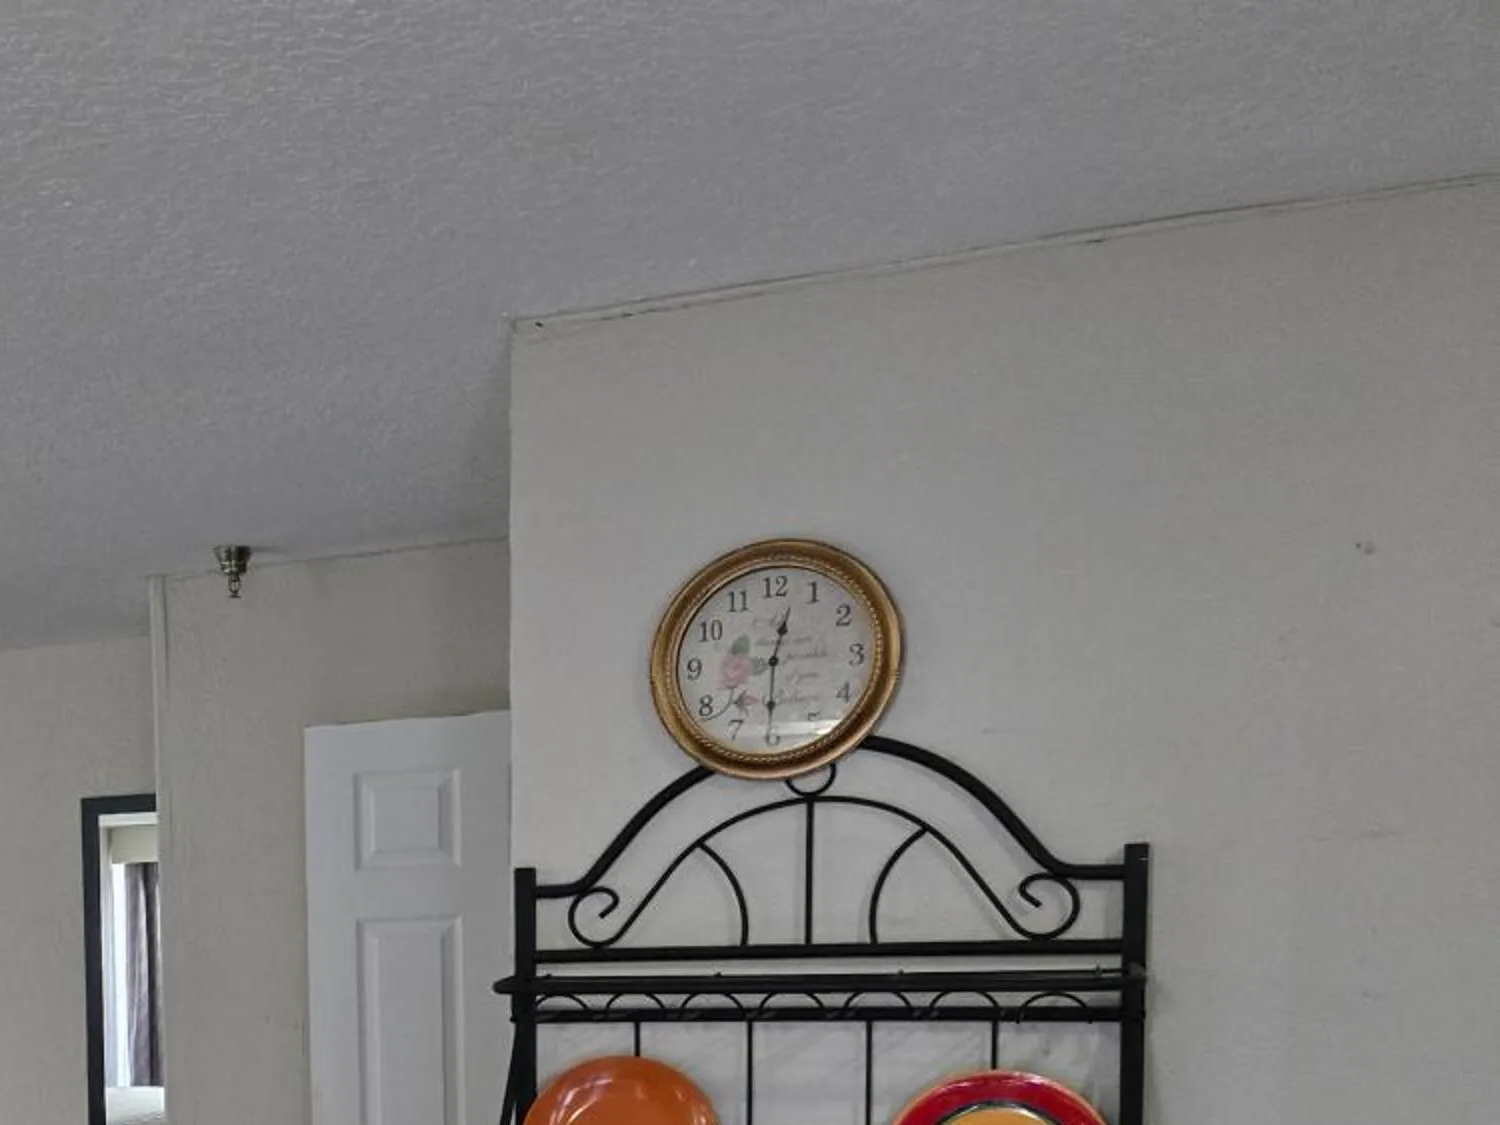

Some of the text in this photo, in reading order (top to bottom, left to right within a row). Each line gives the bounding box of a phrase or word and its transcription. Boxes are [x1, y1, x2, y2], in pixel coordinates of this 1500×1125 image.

[762, 575, 788, 598] 12
[806, 581, 819, 604] 1
[727, 590, 749, 612] 11
[835, 604, 852, 627] 2
[699, 619, 723, 642] 10
[849, 643, 865, 666] 3
[687, 657, 702, 681] 9
[835, 682, 852, 703] 4
[700, 694, 714, 717] 8
[728, 720, 744, 741] 7
